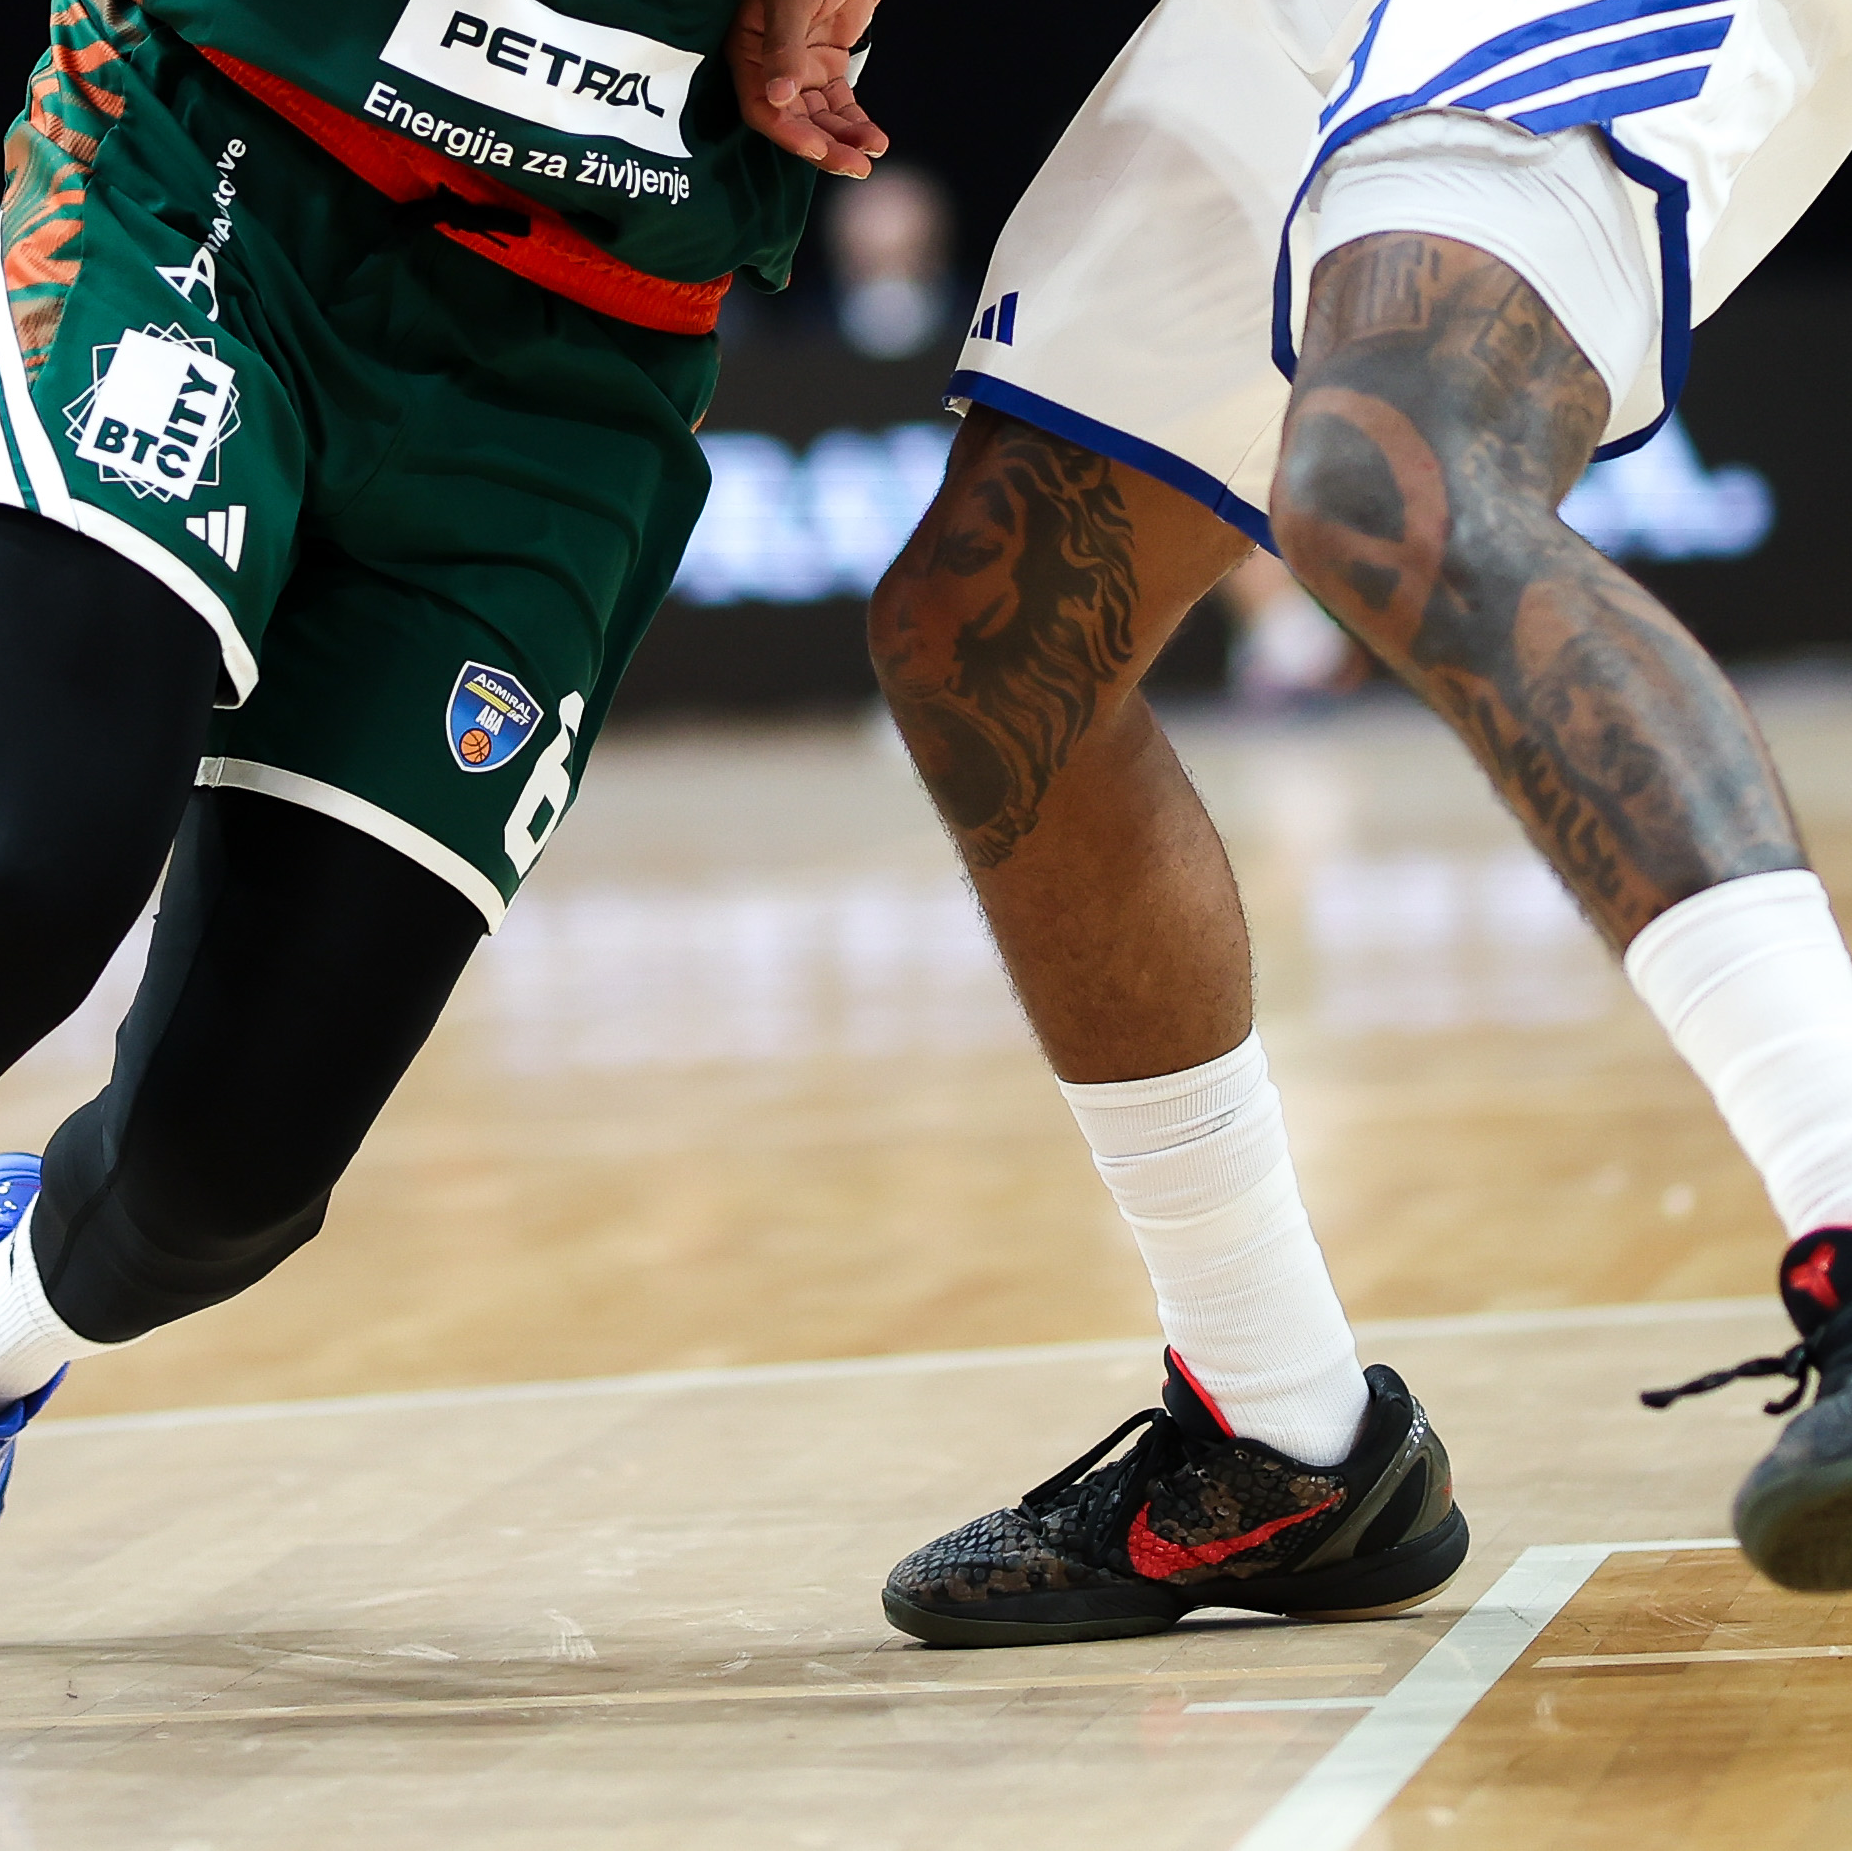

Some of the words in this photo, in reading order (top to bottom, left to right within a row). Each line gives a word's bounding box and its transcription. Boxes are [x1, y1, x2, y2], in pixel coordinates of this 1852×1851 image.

[439, 9, 668, 119] PETROL
[363, 81, 513, 167] Energija
[521, 149, 569, 179] za
[575, 150, 690, 205] življenje
[472, 673, 533, 720] ADMIRAL
[475, 704, 505, 736] ABA
